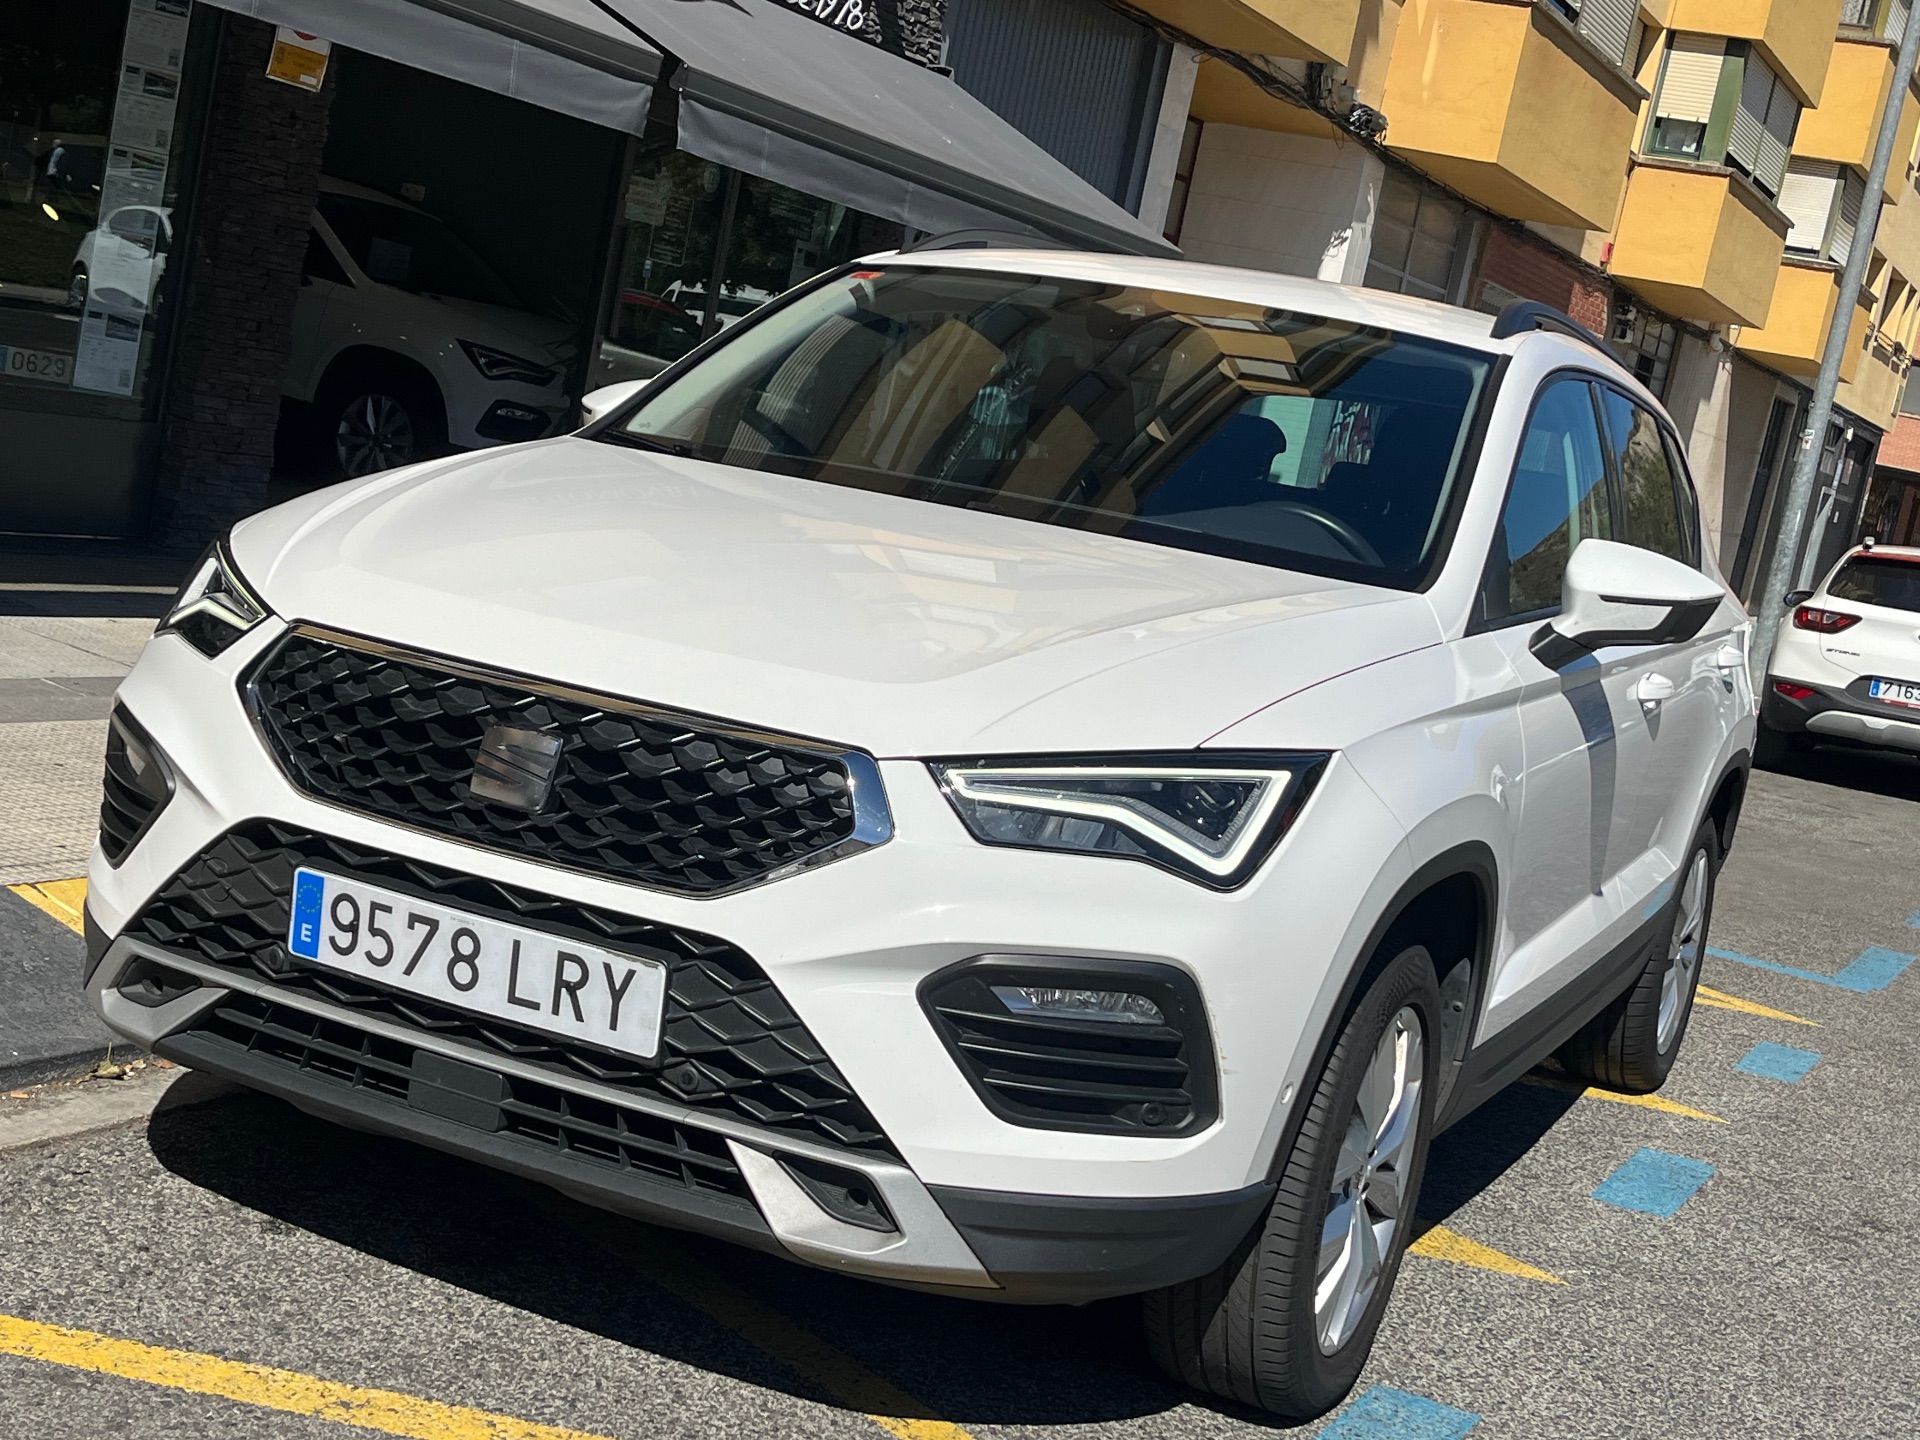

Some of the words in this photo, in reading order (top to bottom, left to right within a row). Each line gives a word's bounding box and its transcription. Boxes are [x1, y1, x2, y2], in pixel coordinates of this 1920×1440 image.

[12, 351, 66, 377] 0629
[300, 922, 313, 943] E
[329, 892, 481, 992] 9578
[507, 939, 637, 1031] LRY
